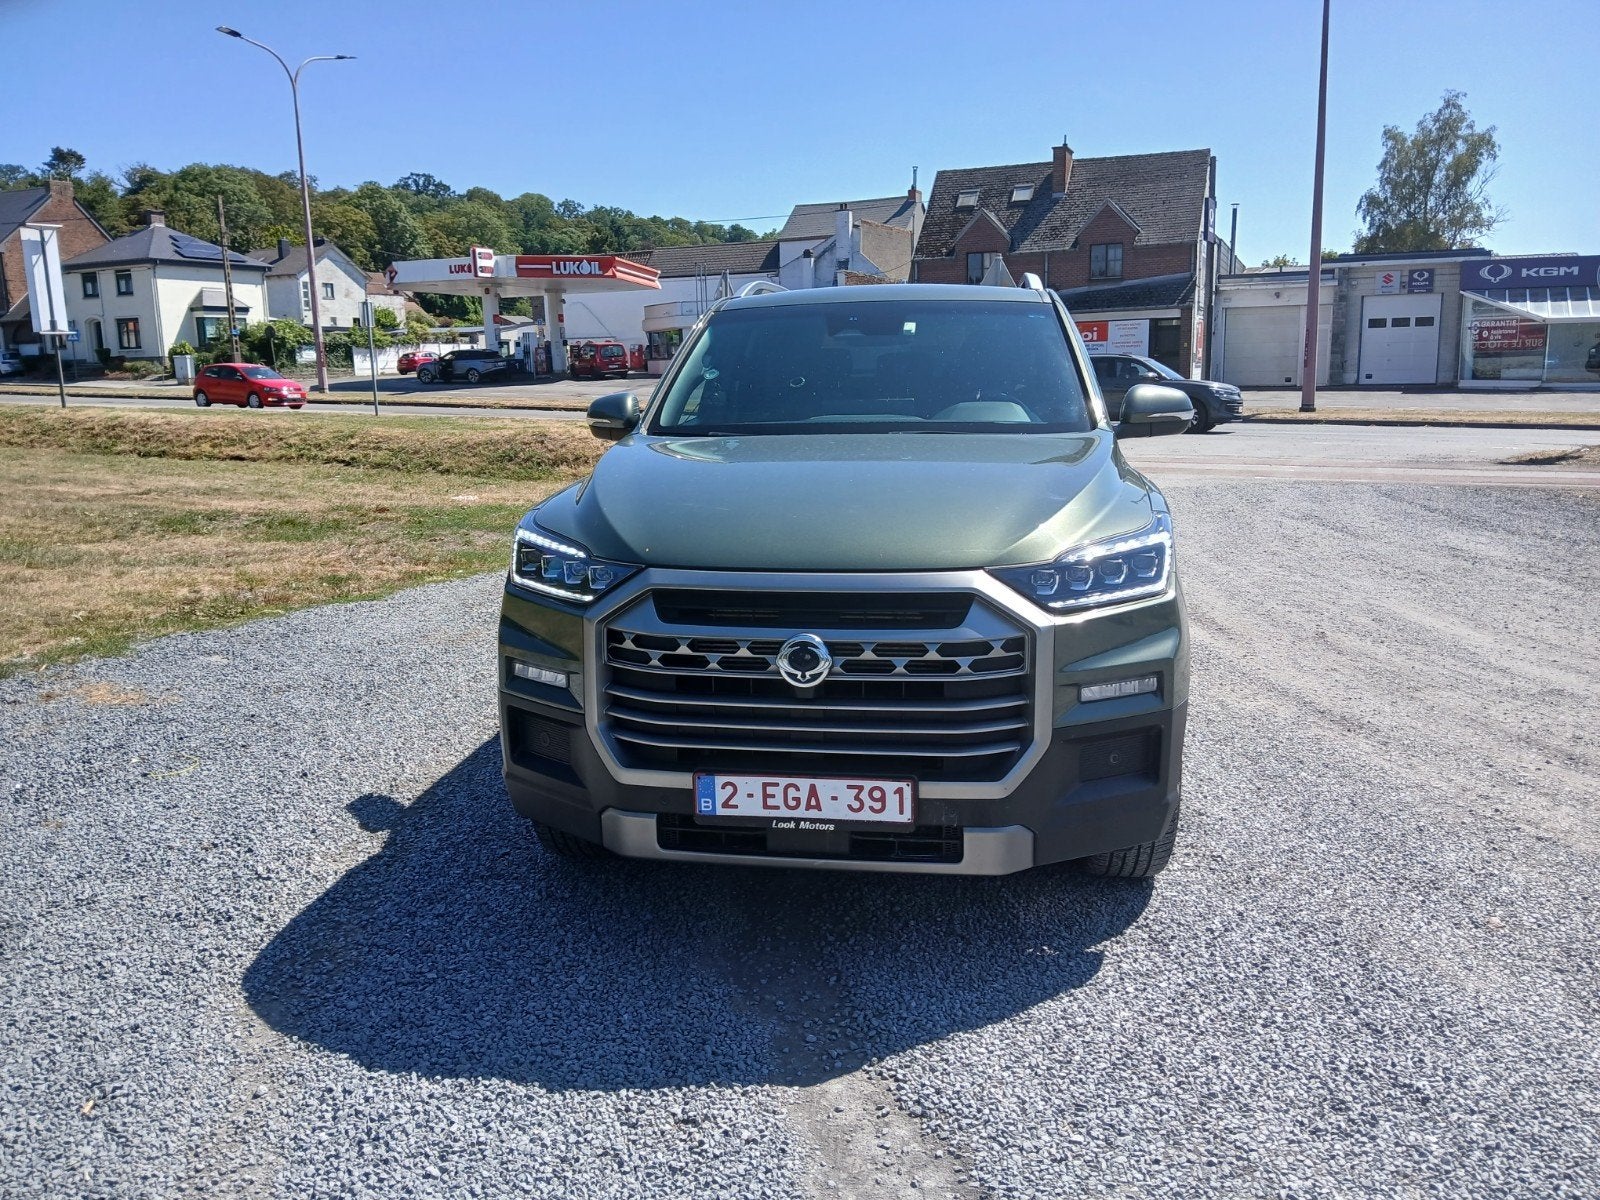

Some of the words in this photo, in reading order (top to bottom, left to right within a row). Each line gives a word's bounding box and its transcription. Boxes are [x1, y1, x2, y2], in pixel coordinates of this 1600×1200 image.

[552, 259, 603, 275] LUKOIL
[1521, 266, 1580, 278] KGM
[701, 798, 713, 811] B
[720, 780, 905, 816] 2-EGA-391
[772, 819, 796, 829] Look
[798, 820, 835, 831] Motors
